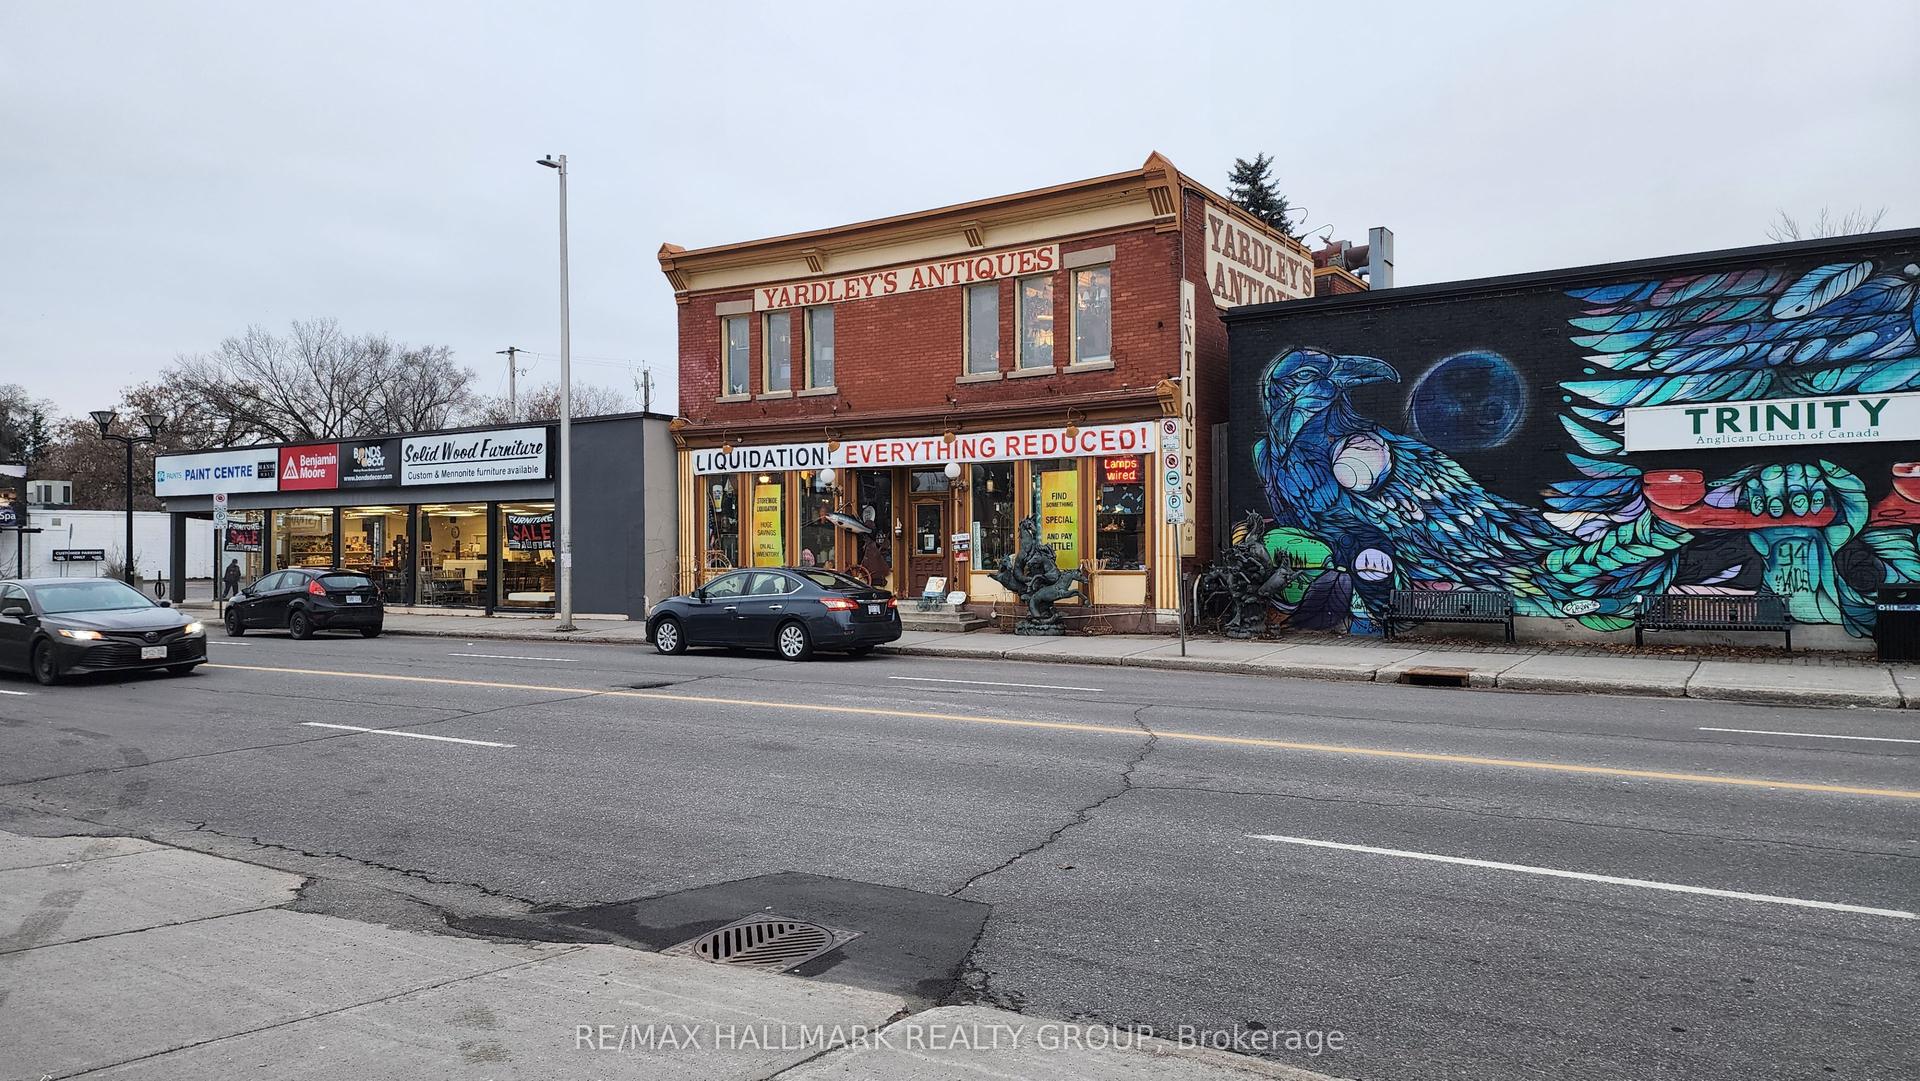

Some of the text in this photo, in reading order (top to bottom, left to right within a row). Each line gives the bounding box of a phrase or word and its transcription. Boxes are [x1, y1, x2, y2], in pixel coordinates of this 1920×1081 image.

[1208, 213, 1312, 297] YARDLEY'S
[763, 246, 1053, 309] YARDLEY'S ANTIQUES
[1184, 298, 1193, 503] ANTIQUES
[1685, 398, 1891, 435] TRINITY
[1696, 428, 1880, 446] Anglican Church of Canada
[403, 438, 544, 463] Solid Wood Furniture
[696, 427, 1147, 472] LIQUIDATION! EVERYTHING REDUCED!
[299, 453, 337, 468] Benjamin
[1104, 459, 1137, 469] Lamps
[185, 468, 211, 480] PAINT
[214, 465, 253, 479] CENTRE
[299, 468, 326, 479] Moore
[407, 464, 539, 480] Custom & Mennonite furniture available
[1106, 471, 1136, 481] wired
[1051, 492, 1067, 500] FIND
[508, 513, 554, 524] FURNITURE
[1045, 516, 1073, 524] SPECIAL
[230, 530, 258, 544] SALE
[512, 523, 551, 540] SALE
[1060, 532, 1073, 540] PAY
[1047, 542, 1073, 550] ITTLE!
